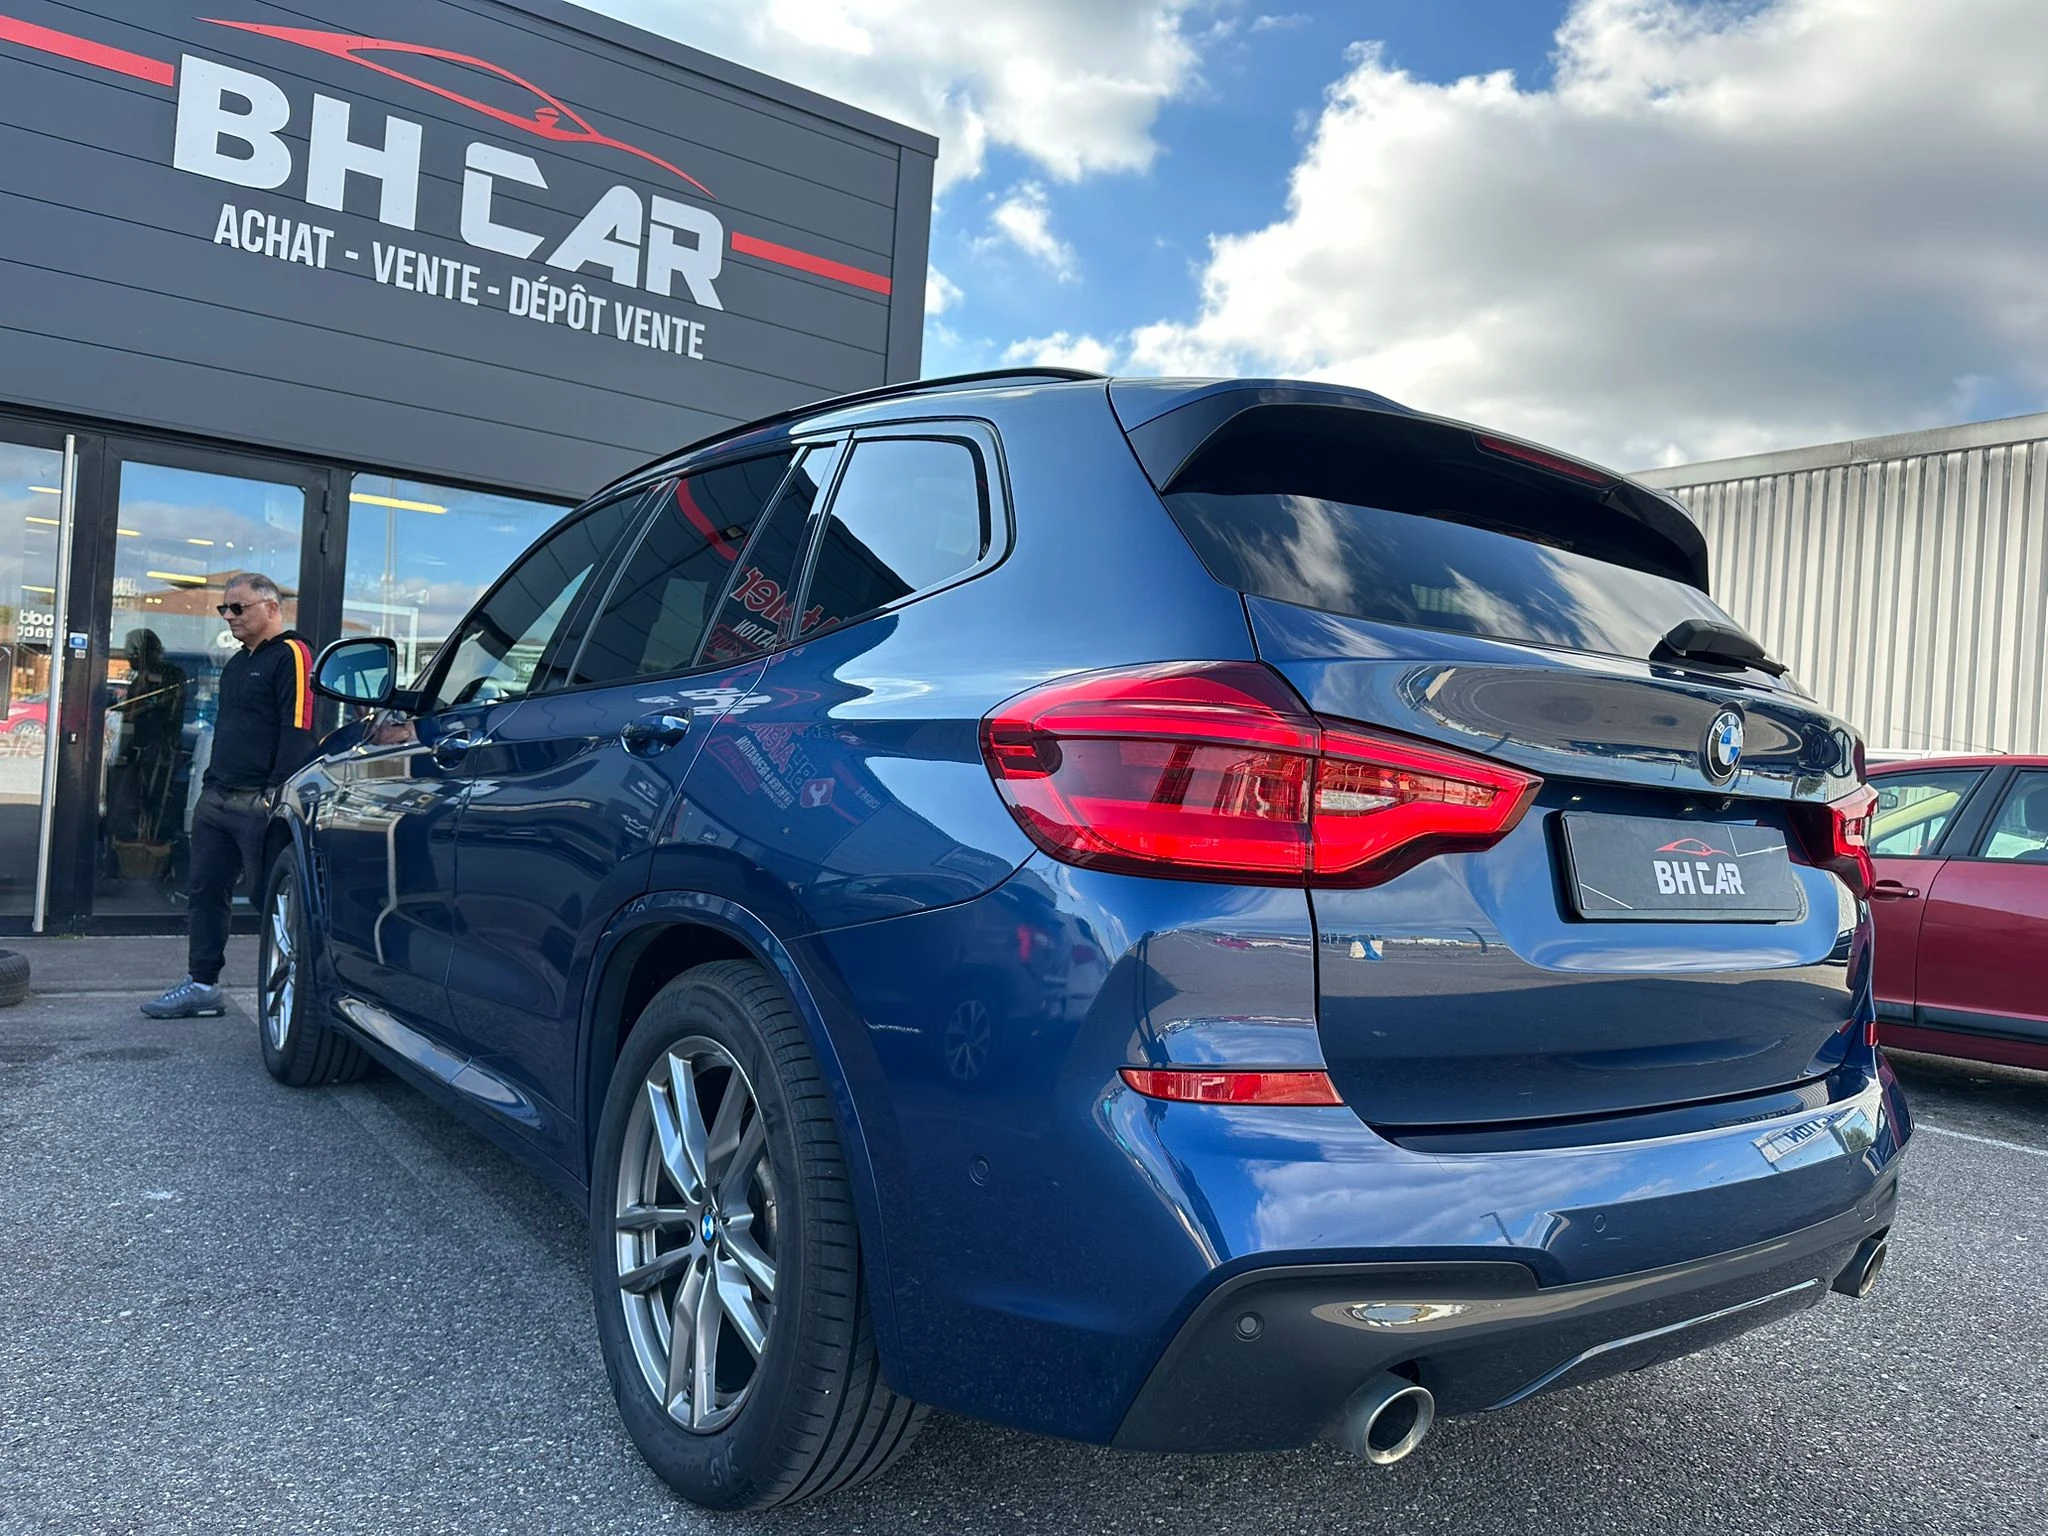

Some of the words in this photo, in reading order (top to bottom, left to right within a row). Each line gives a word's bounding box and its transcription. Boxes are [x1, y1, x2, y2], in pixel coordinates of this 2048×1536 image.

[173, 53, 423, 231] BH
[460, 142, 724, 311] CAR
[213, 203, 335, 269] ACHAT
[372, 241, 481, 306] VENTE
[508, 274, 607, 335] DÉPÔT
[614, 301, 706, 361] VENTE
[1653, 860, 1696, 895] BH
[1695, 861, 1746, 895] CAR
